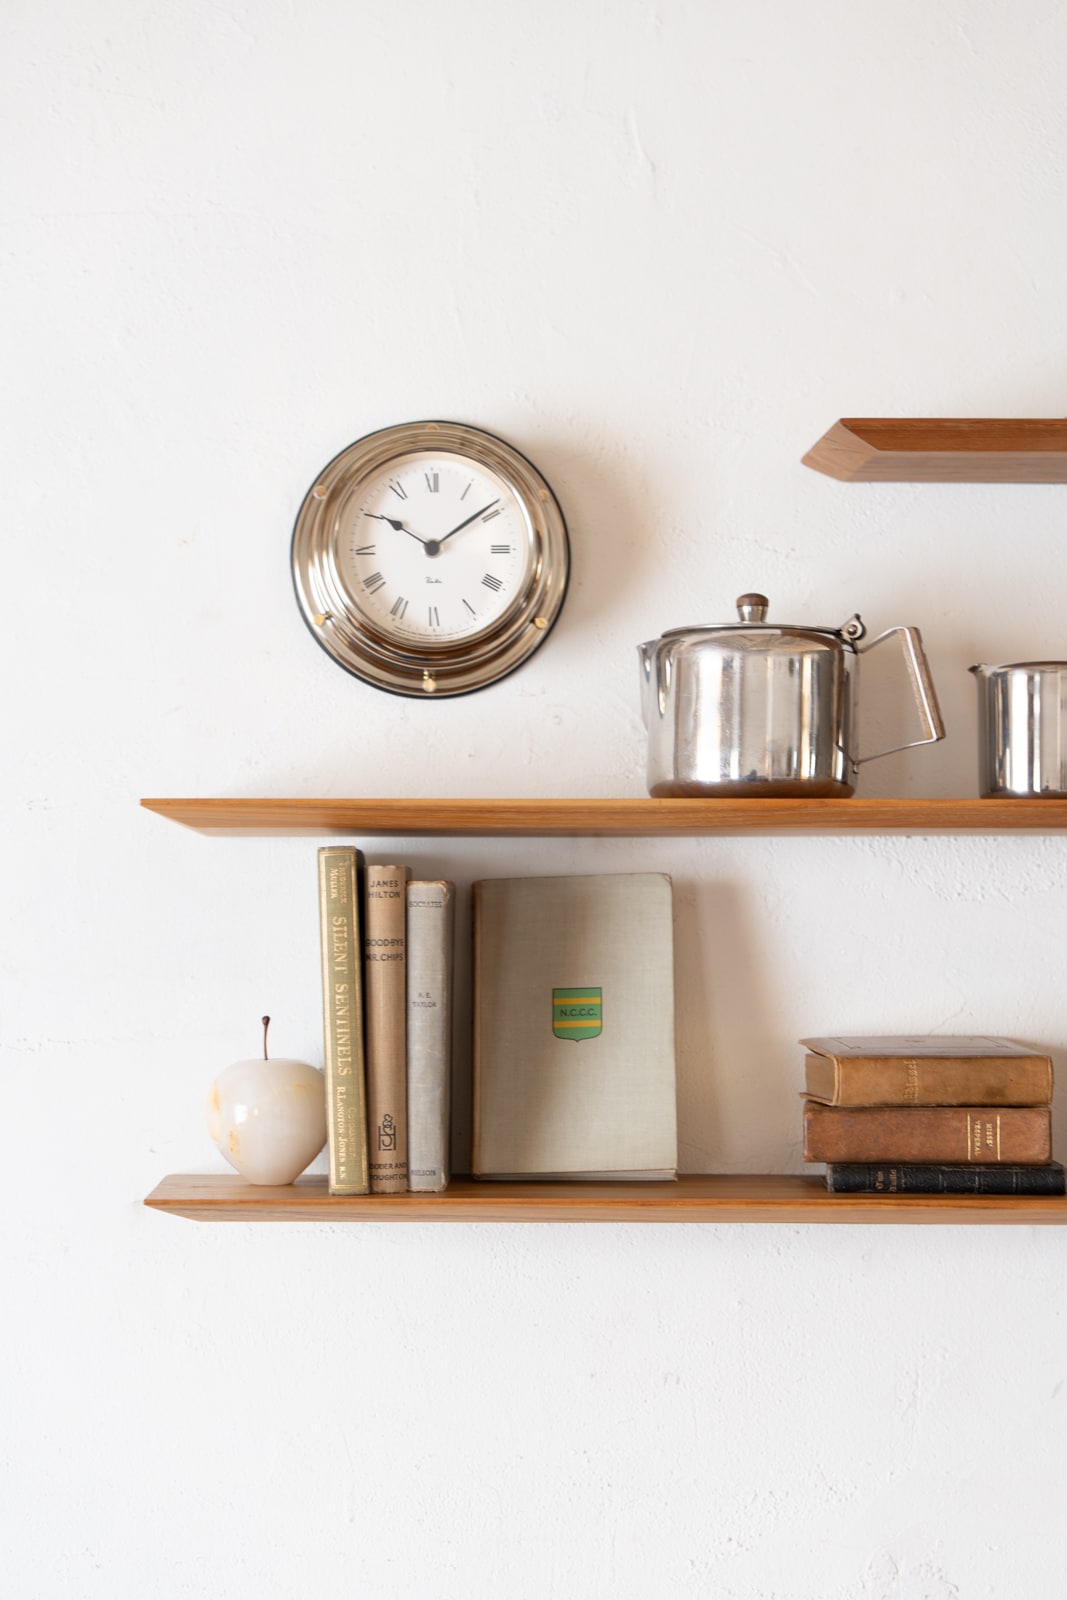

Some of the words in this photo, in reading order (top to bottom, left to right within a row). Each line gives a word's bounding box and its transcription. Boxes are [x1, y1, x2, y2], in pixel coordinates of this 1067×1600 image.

[370, 880, 400, 888] JAMES
[368, 890, 401, 898] HILTON
[333, 916, 349, 975] SILENT
[380, 953, 404, 961] CHIPS
[335, 983, 352, 1076] SENTINELS
